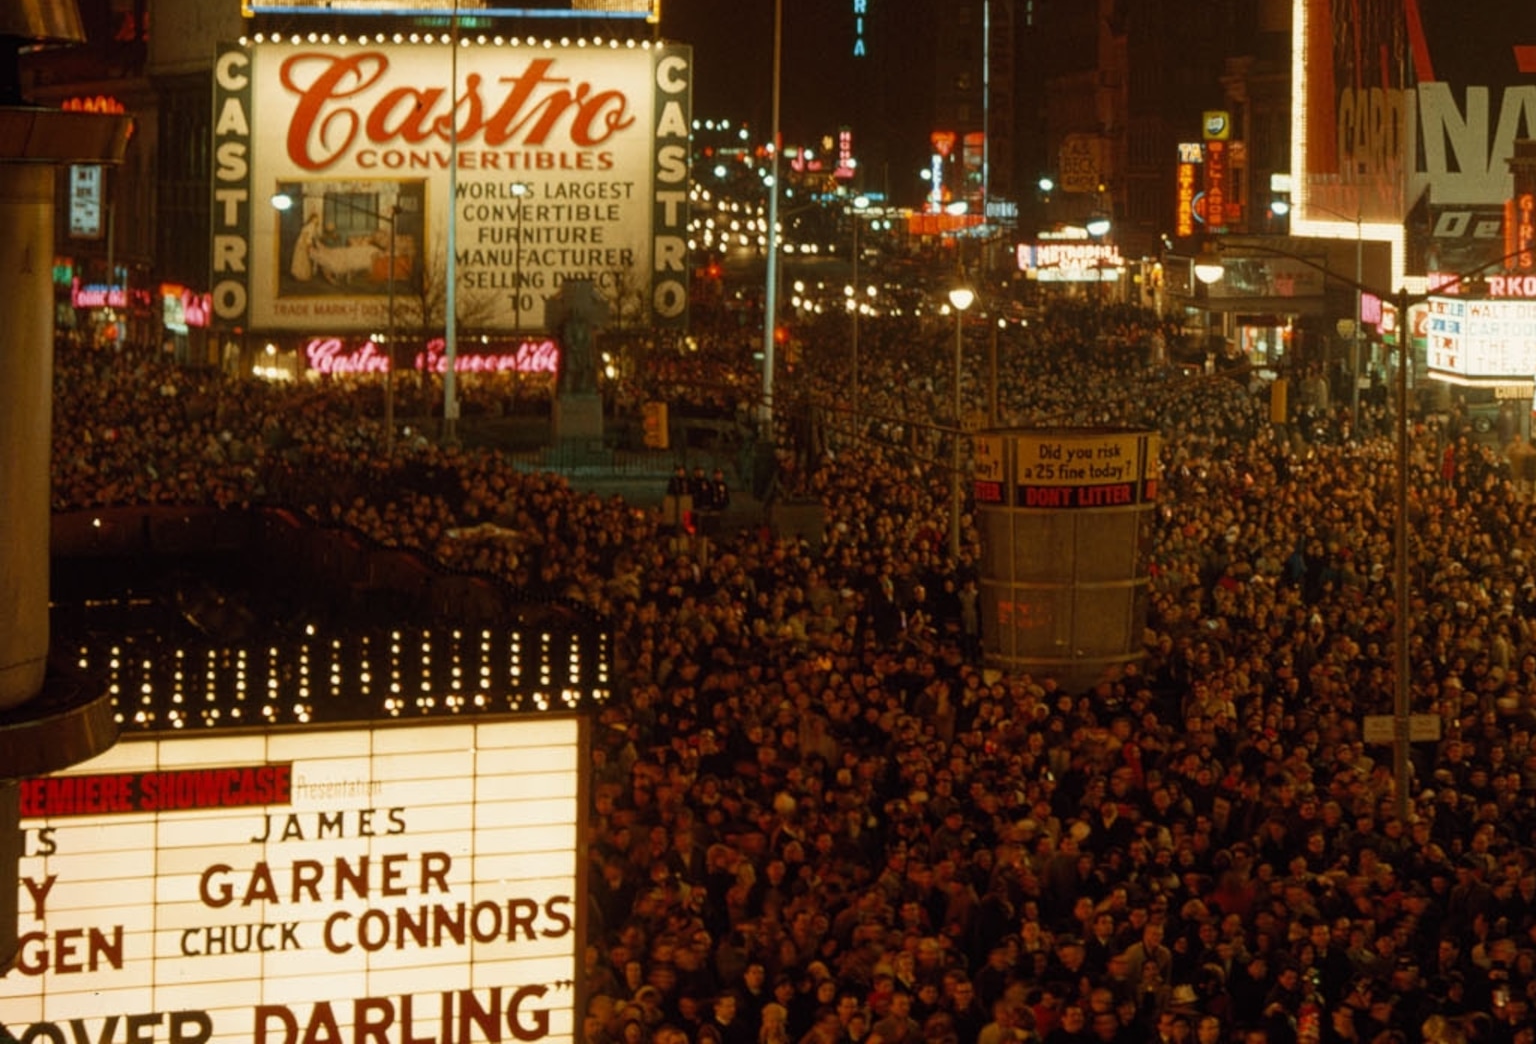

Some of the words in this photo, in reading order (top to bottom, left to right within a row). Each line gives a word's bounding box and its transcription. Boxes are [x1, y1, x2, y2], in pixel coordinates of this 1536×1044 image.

[279, 50, 637, 172] Castro
[356, 148, 615, 171] CONVERTIBLES
[213, 50, 249, 320] CASTRO
[544, 181, 635, 200] LARGEST
[655, 56, 689, 319] CASTRO
[462, 204, 622, 222] CONVERTIBLE
[477, 226, 605, 245] FURNITURE
[455, 249, 635, 267] MANUFACTURER
[463, 271, 546, 289] SELLING
[509, 294, 534, 312] TO
[1039, 444, 1061, 460] Did
[1066, 448, 1093, 463] you
[1097, 443, 1121, 458] risk
[1024, 466, 1032, 479] a
[1059, 463, 1086, 480] fine
[1025, 487, 1072, 507] DON'T
[1078, 483, 1132, 505] LITTER
[140, 764, 290, 811] SHOWCASE
[251, 807, 406, 844] JAMES
[199, 851, 451, 908] GARNER
[181, 922, 301, 957] CHUCK
[324, 895, 571, 954] CONNORS
